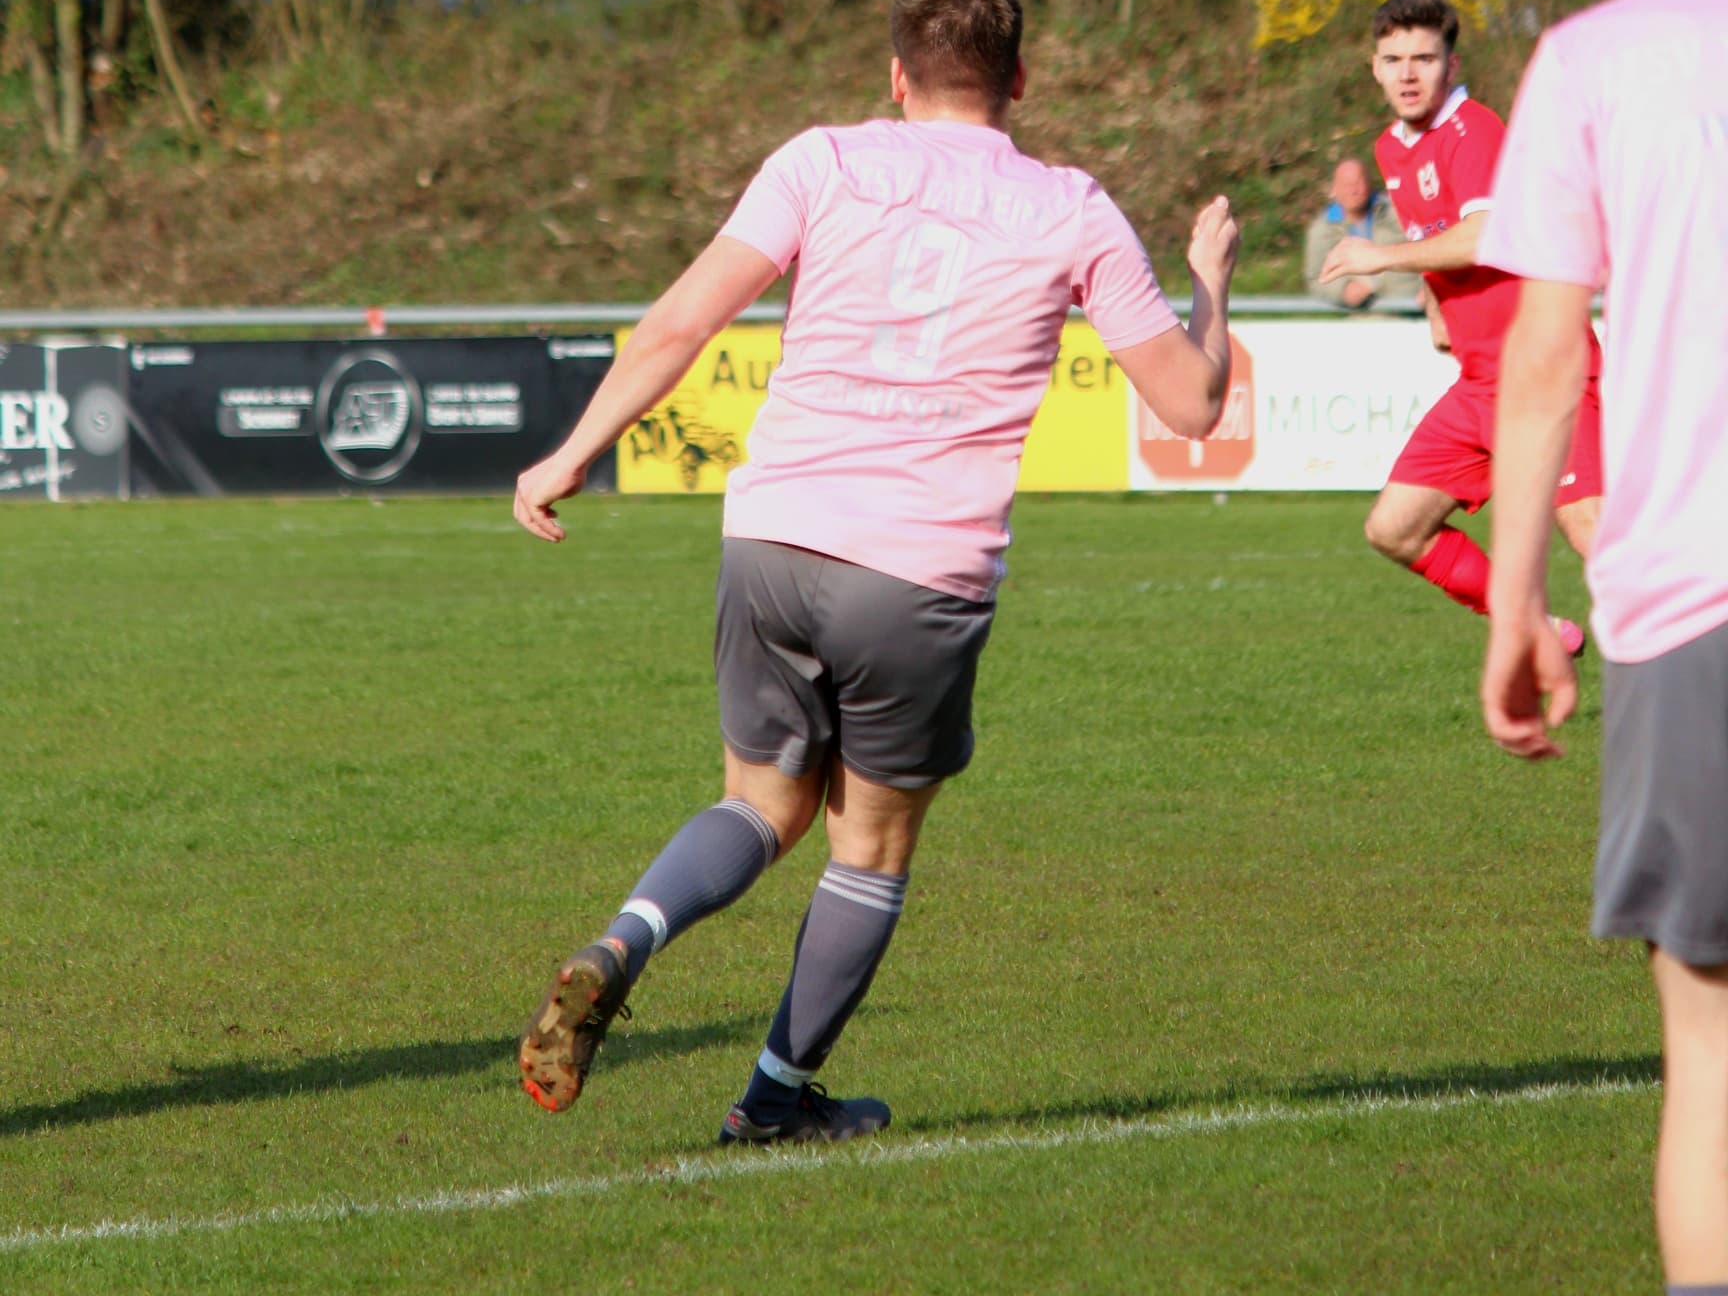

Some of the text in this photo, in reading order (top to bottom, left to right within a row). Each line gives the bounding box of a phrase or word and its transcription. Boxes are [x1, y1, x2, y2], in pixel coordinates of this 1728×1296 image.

[870, 223, 970, 380] 9
[710, 350, 771, 390] Au
[0, 391, 74, 449] ER
